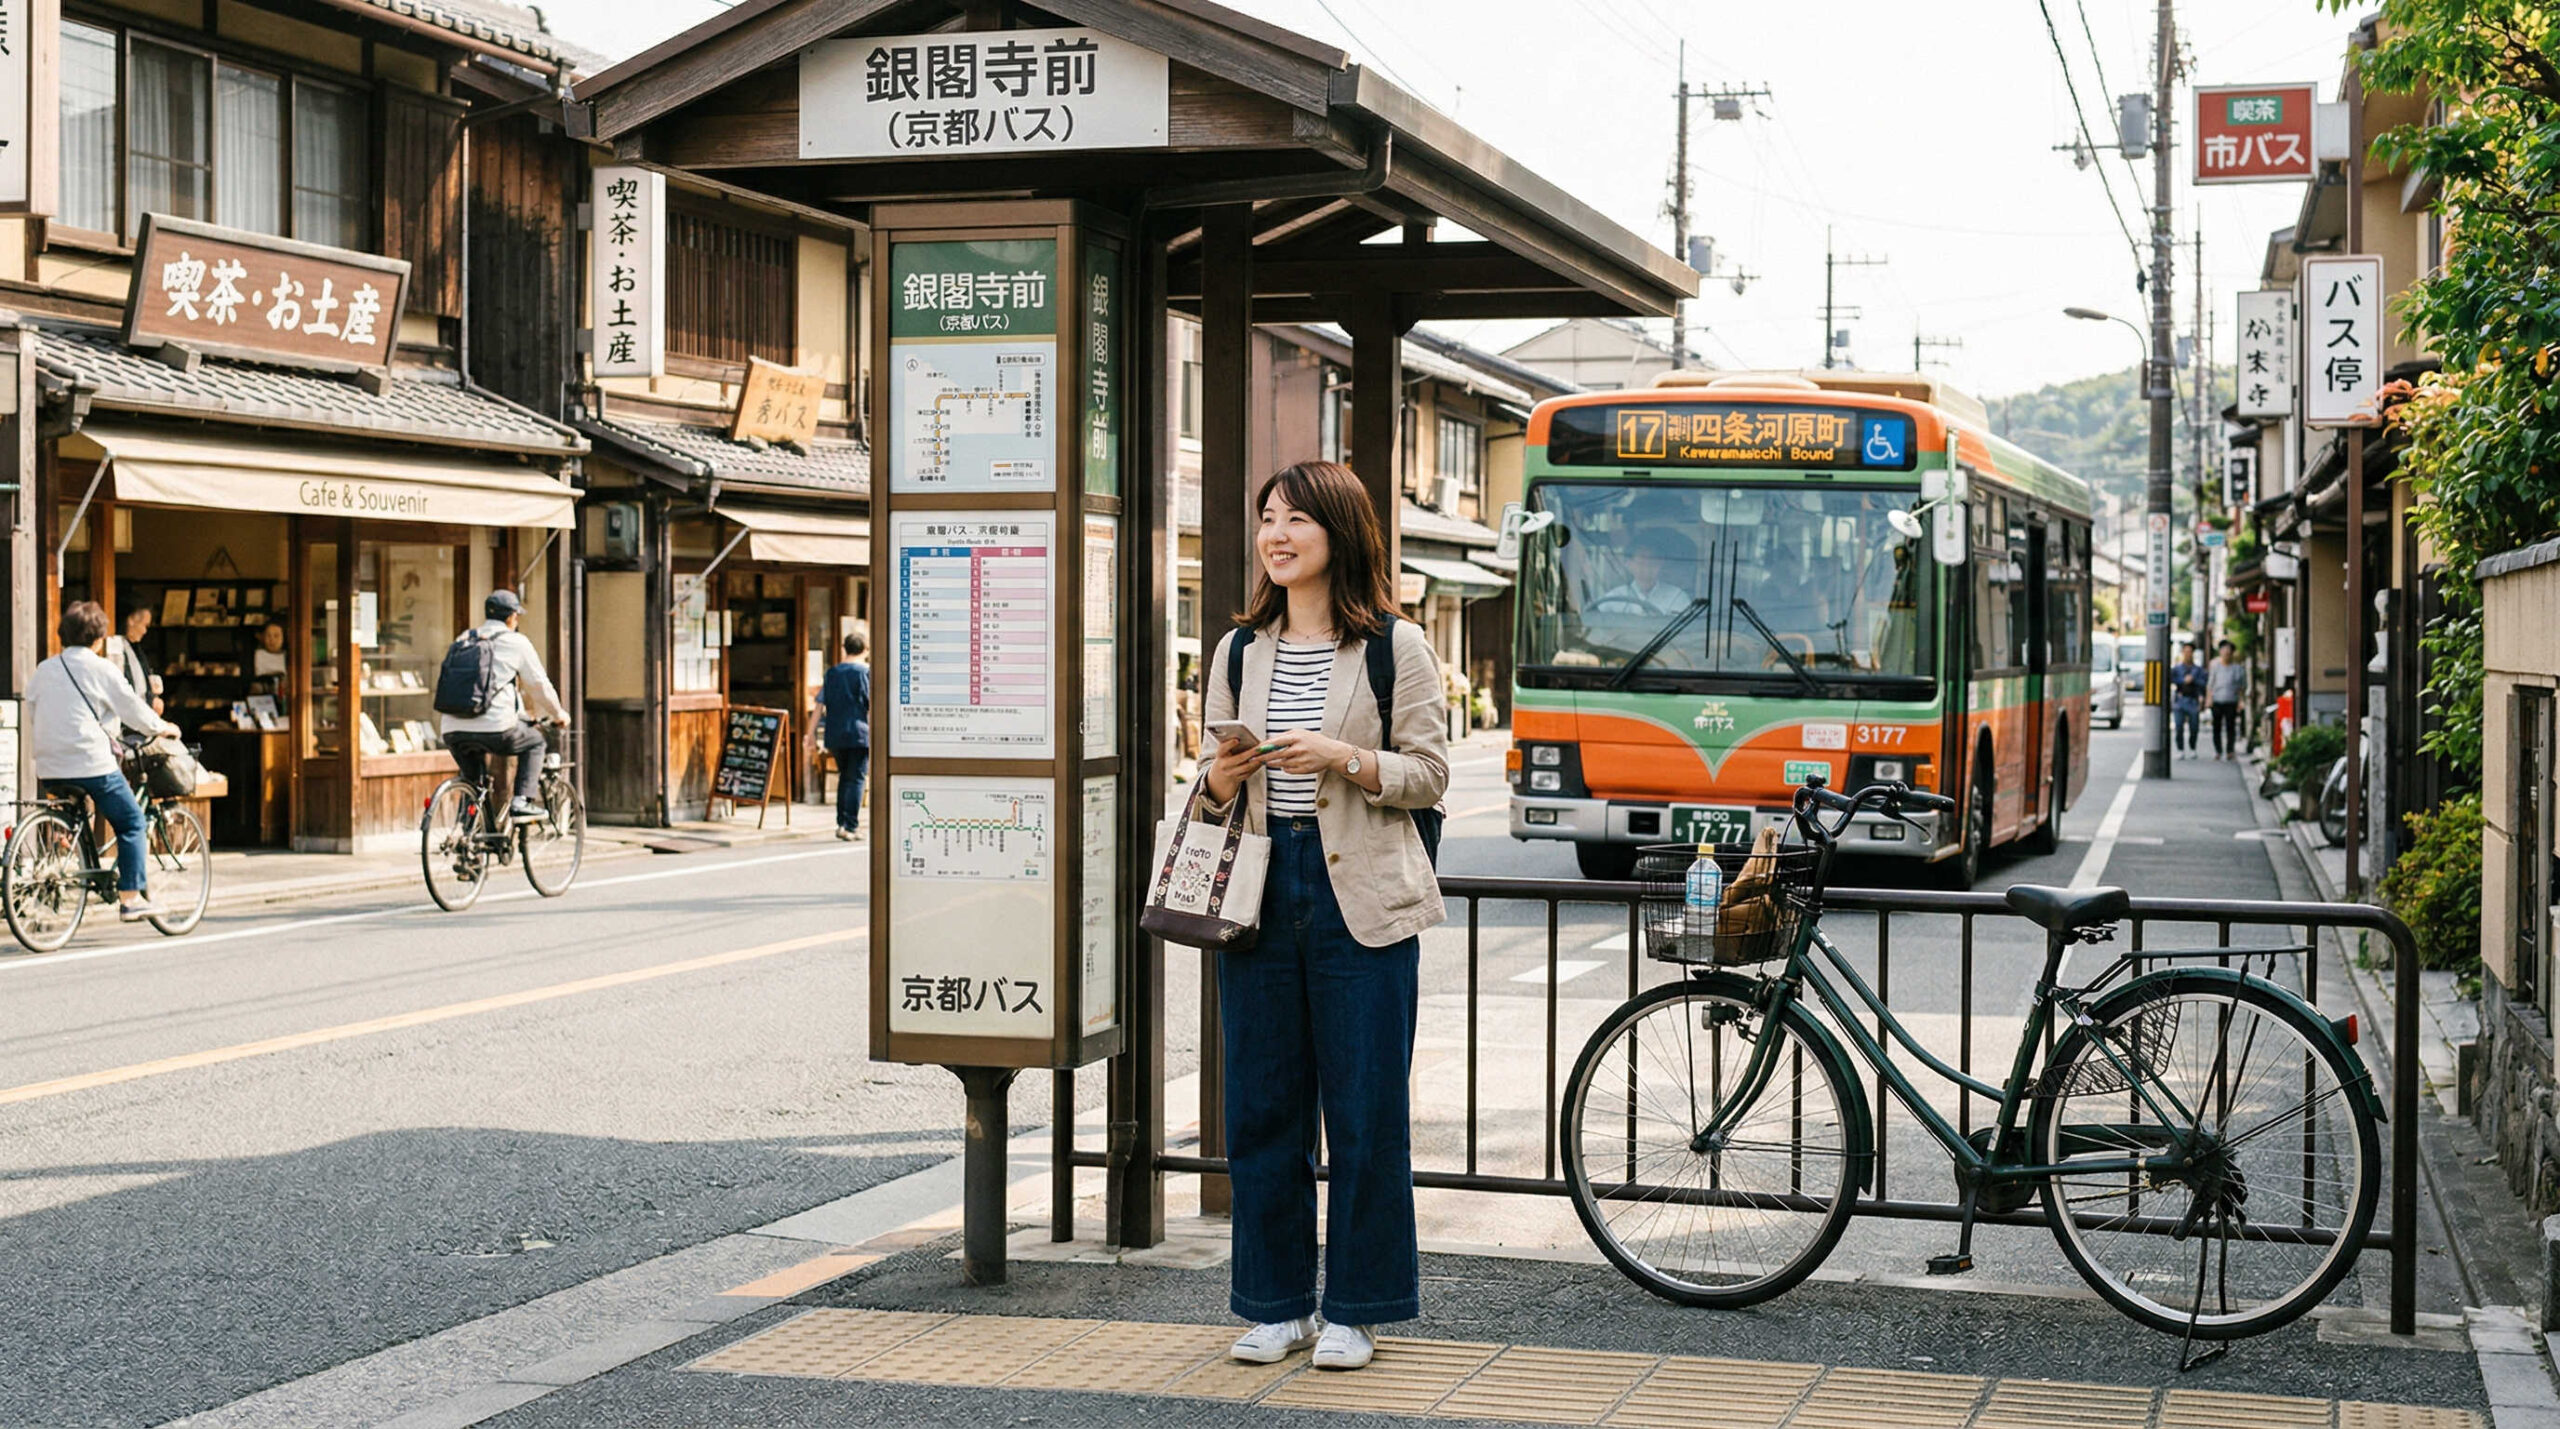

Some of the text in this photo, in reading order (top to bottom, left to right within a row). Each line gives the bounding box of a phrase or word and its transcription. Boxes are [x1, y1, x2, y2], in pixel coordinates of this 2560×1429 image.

[866, 37, 1099, 102] 銀閣寺前
[888, 104, 1075, 148] （京都バス）
[2232, 99, 2277, 121] 喫茶
[2204, 132, 2305, 169] 市バス
[606, 177, 639, 365] 喫茶・お土産
[902, 270, 1047, 310] 銀閣寺前
[162, 251, 381, 346] 喫茶・お土産
[2325, 274, 2363, 393] バス停
[1622, 415, 1662, 453] 17
[1692, 411, 1850, 448] 四条河原町
[1791, 447, 1834, 461] Bound
[299, 481, 429, 514] Cafe & Souvenir
[1857, 725, 1907, 745] 3177
[902, 974, 1043, 1014] 京都バス
